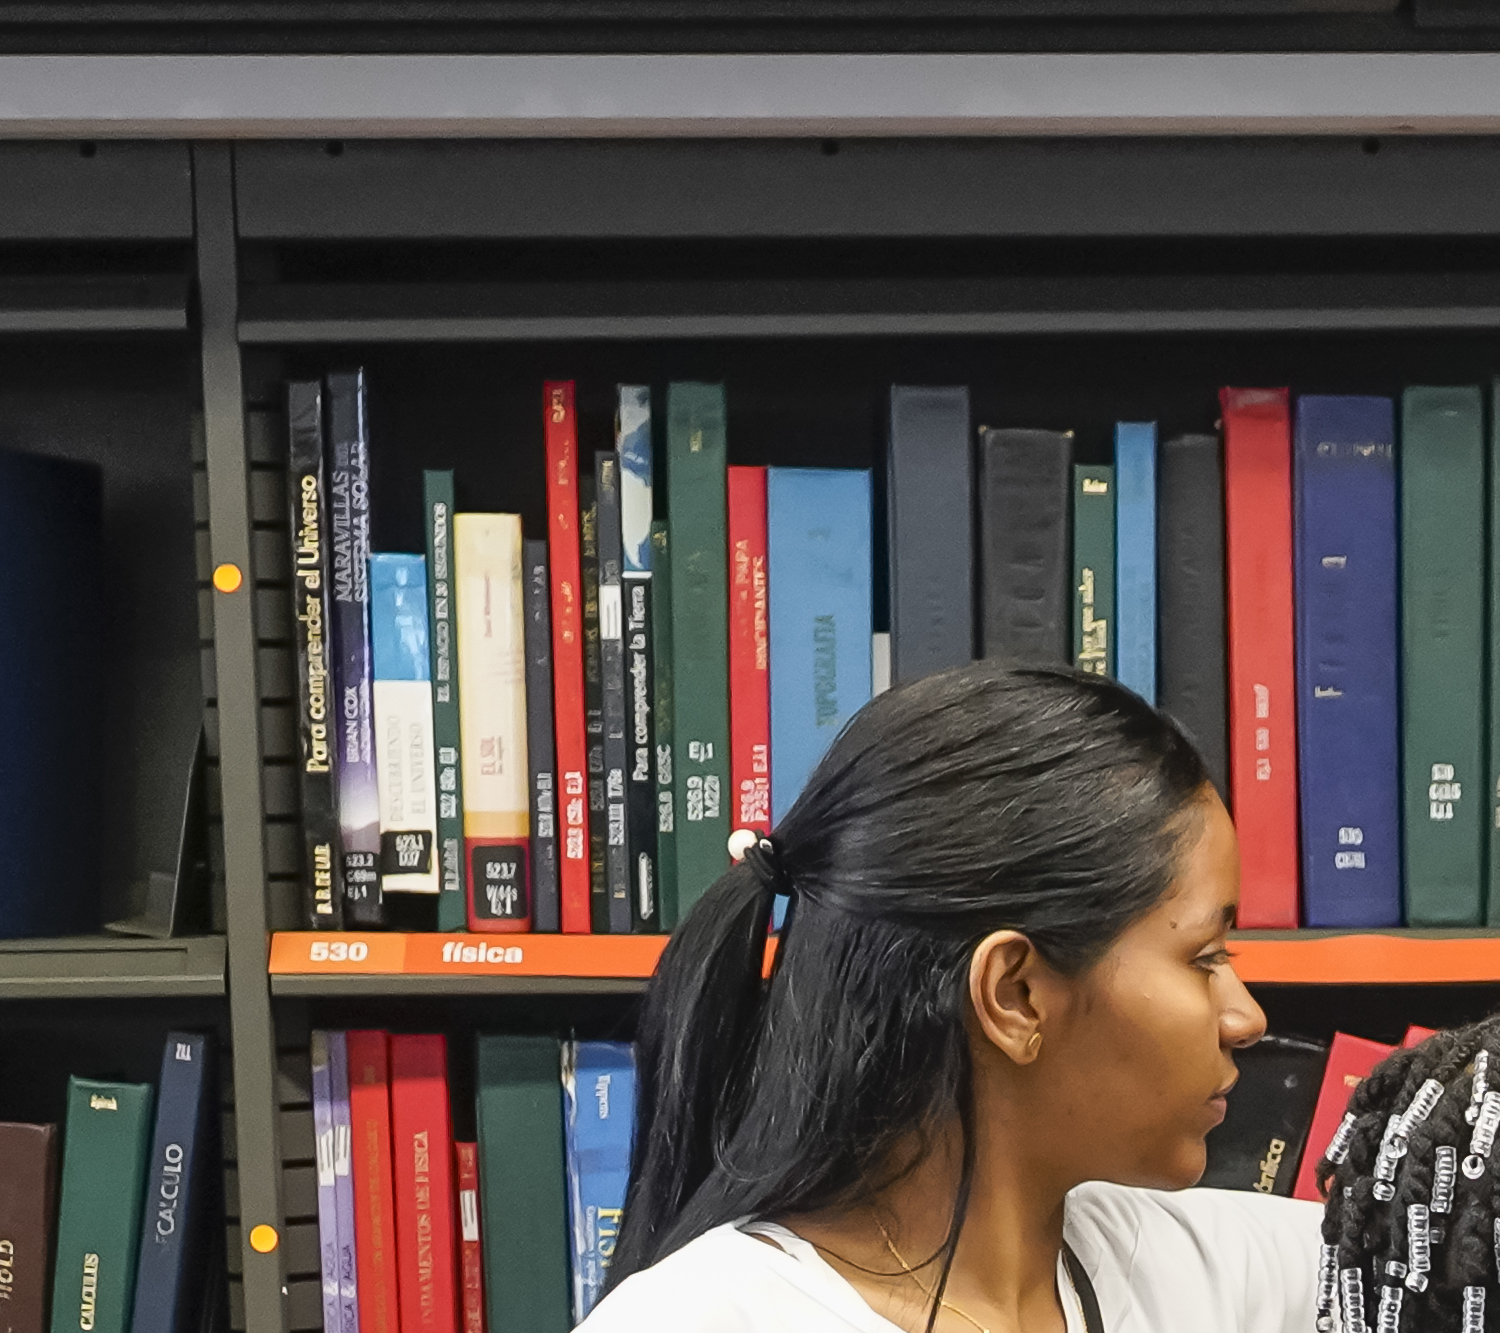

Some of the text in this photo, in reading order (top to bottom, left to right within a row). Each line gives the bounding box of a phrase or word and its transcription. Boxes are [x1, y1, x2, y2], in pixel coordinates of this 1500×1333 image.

[333, 471, 352, 602] MARAVILLAS
[296, 475, 330, 772] Para comprender el Universo
[627, 585, 646, 630] Tierra
[344, 686, 359, 719] COX
[631, 653, 651, 744] comprender
[632, 747, 650, 781] Para
[310, 941, 523, 966] 530 física
